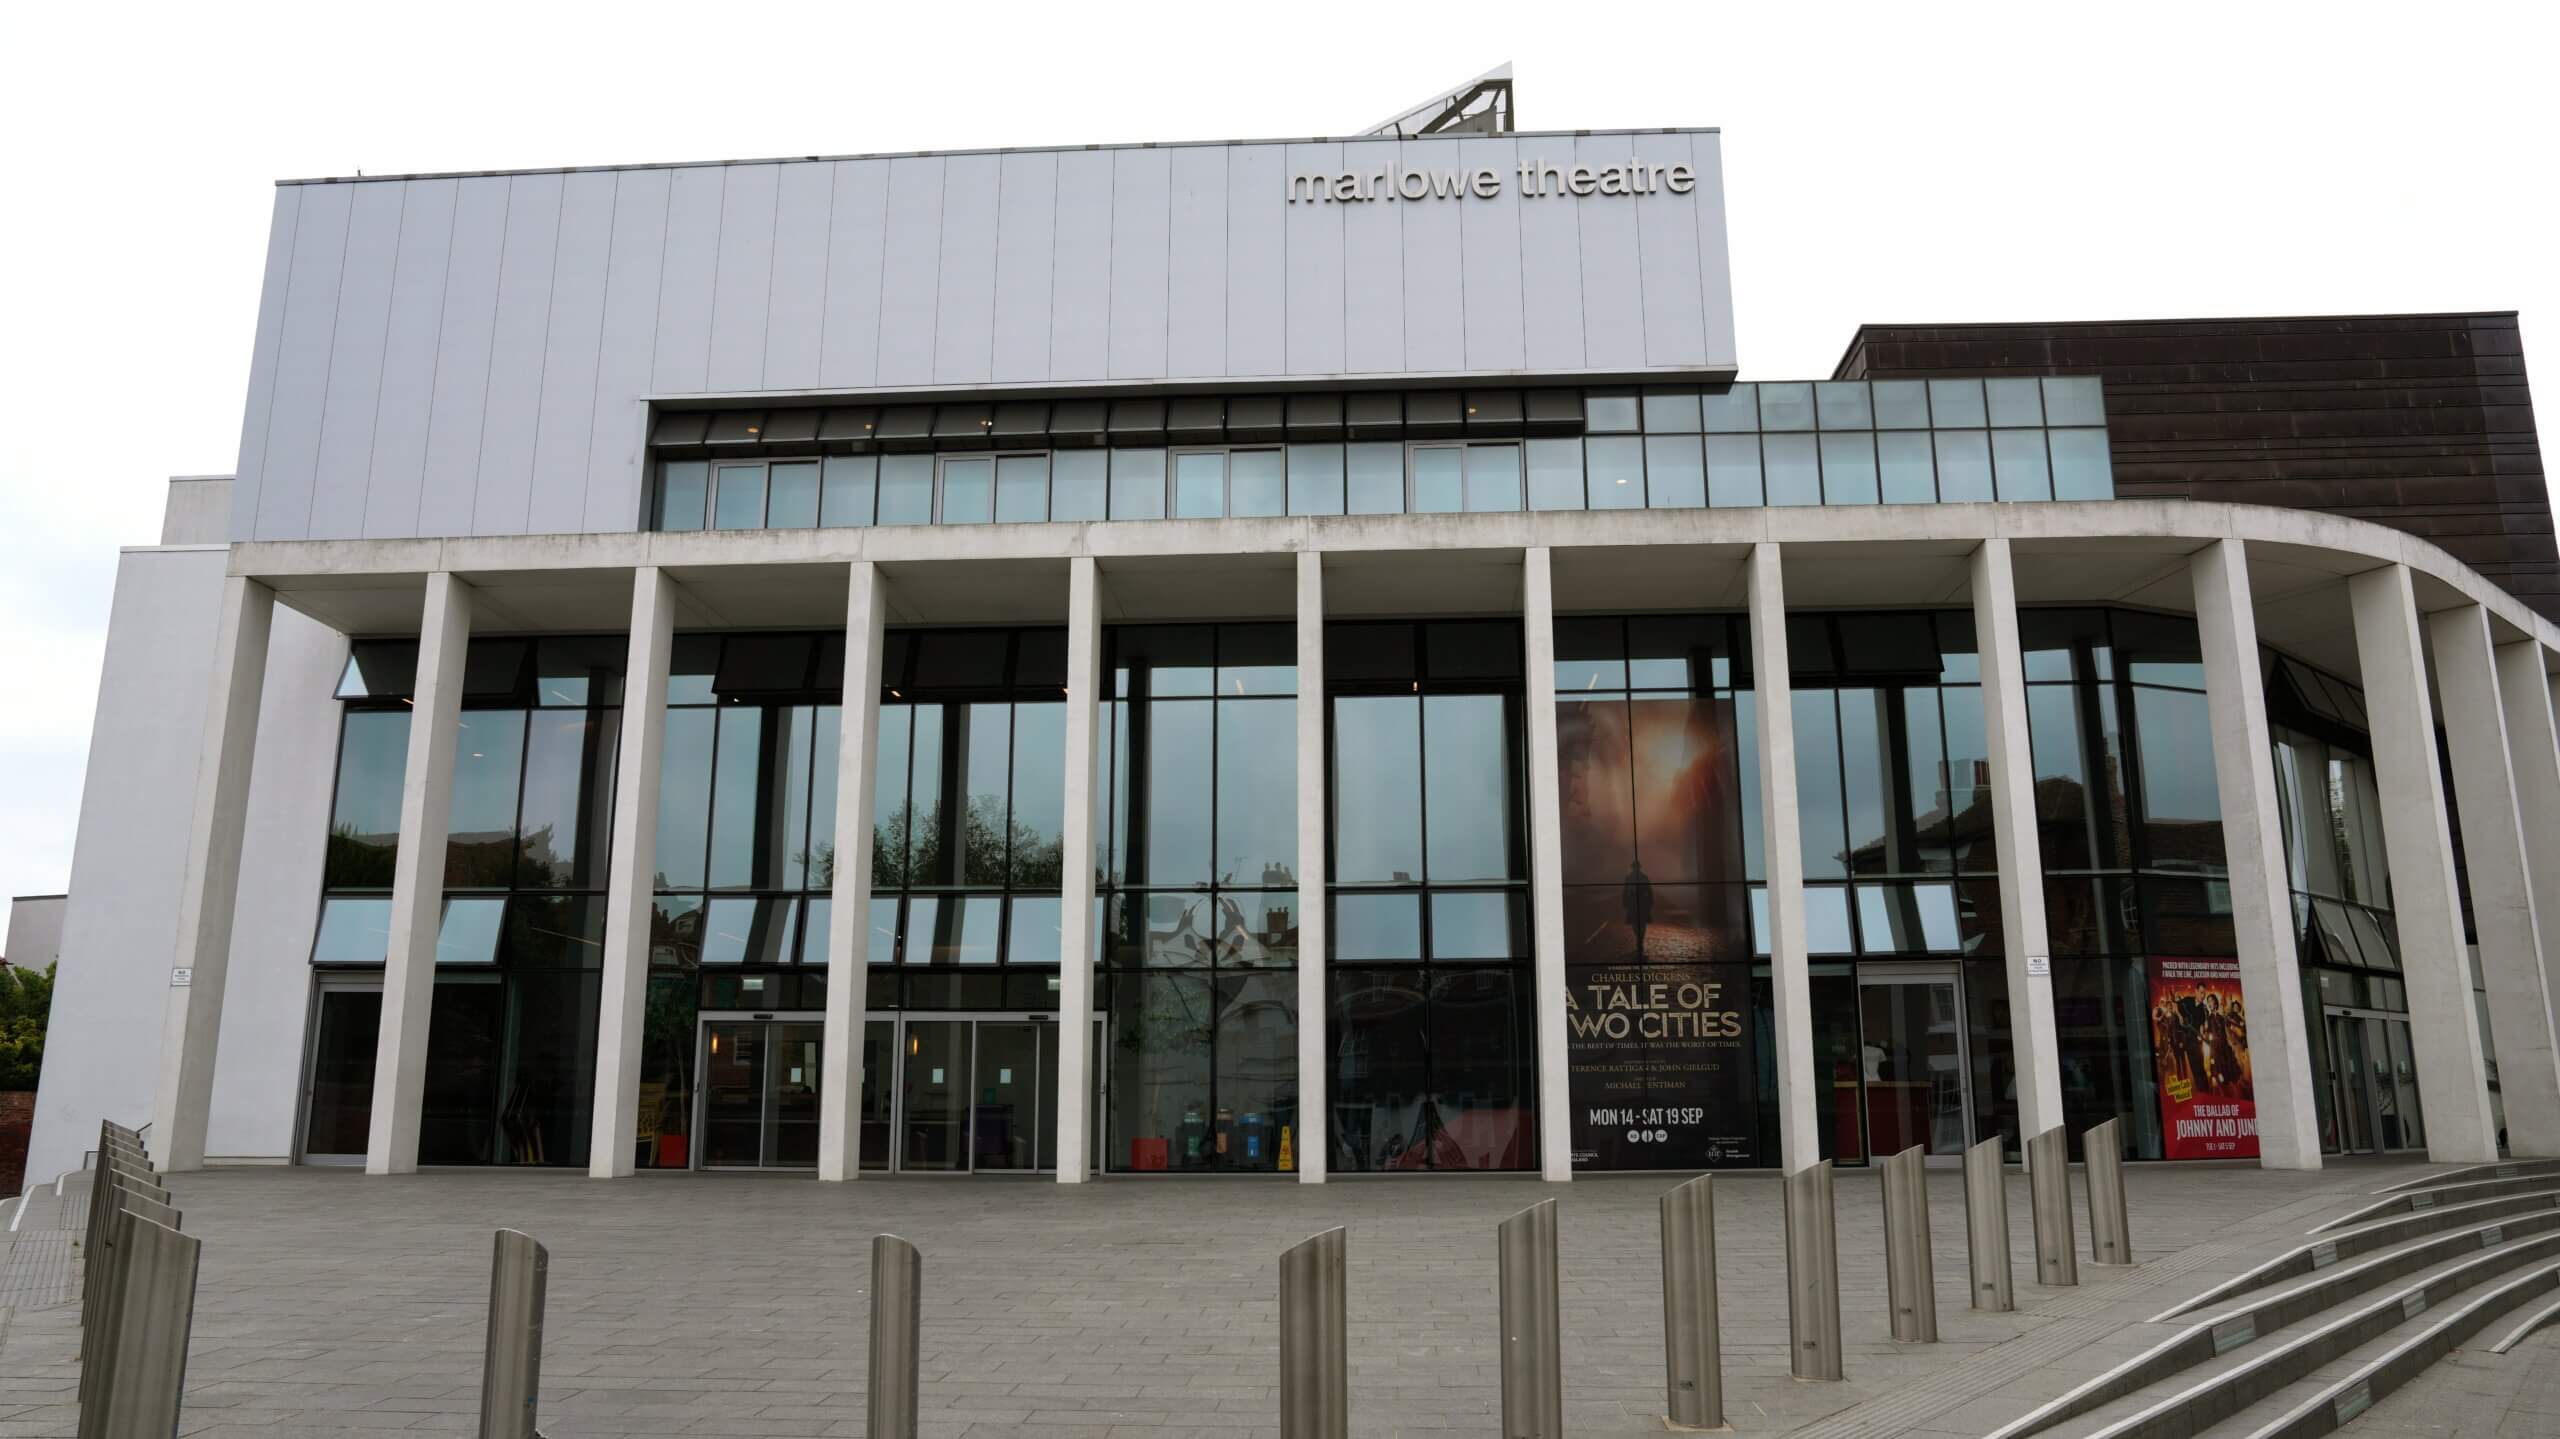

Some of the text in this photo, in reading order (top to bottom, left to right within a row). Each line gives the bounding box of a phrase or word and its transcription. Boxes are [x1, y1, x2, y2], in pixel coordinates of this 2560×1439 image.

[1288, 156, 1695, 203] marlowe theatre
[1591, 973, 1640, 982] CHARLES
[1587, 984, 1669, 1010] TALE
[1677, 983, 1722, 1009] OF
[1567, 1011, 1742, 1039] WO CITIES
[1571, 1064, 1606, 1073] TERENCE
[1659, 1064, 1681, 1073] JOHN
[1647, 1080, 1686, 1089] ENTIMAN
[1589, 1108, 1618, 1126] MON
[1620, 1108, 1634, 1126] 14
[1642, 1107, 1664, 1126] SAT
[1665, 1107, 1679, 1125] 19
[1681, 1107, 1704, 1125] SEP
[2192, 1104, 2240, 1118] THE BALLAD OF
[2176, 1119, 2213, 1141] JOHNNY
[2216, 1118, 2237, 1137] AND
